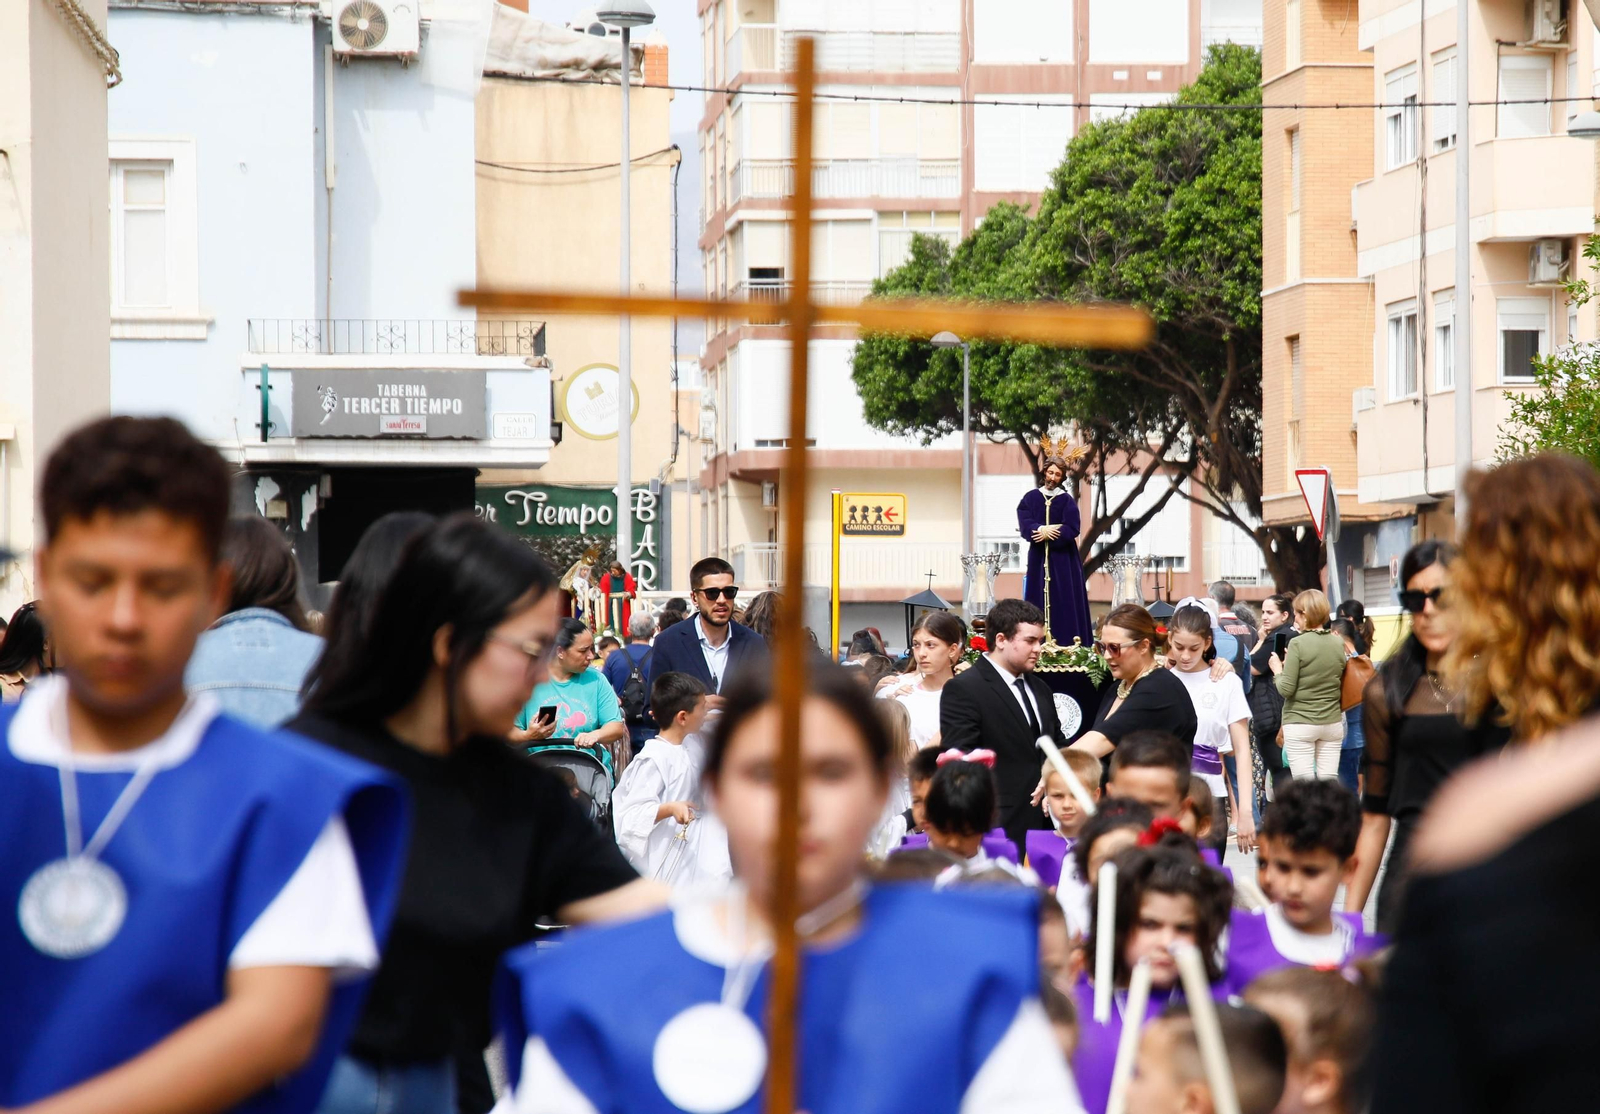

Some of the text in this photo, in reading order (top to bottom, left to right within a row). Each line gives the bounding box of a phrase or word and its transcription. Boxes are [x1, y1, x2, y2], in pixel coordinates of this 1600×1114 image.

[377, 384, 427, 397] TABERNA
[342, 397, 462, 415] TERCER TIEMPO
[502, 426, 528, 437] TEJAR
[504, 490, 613, 534] Tiempo
[629, 488, 657, 592] BAR
